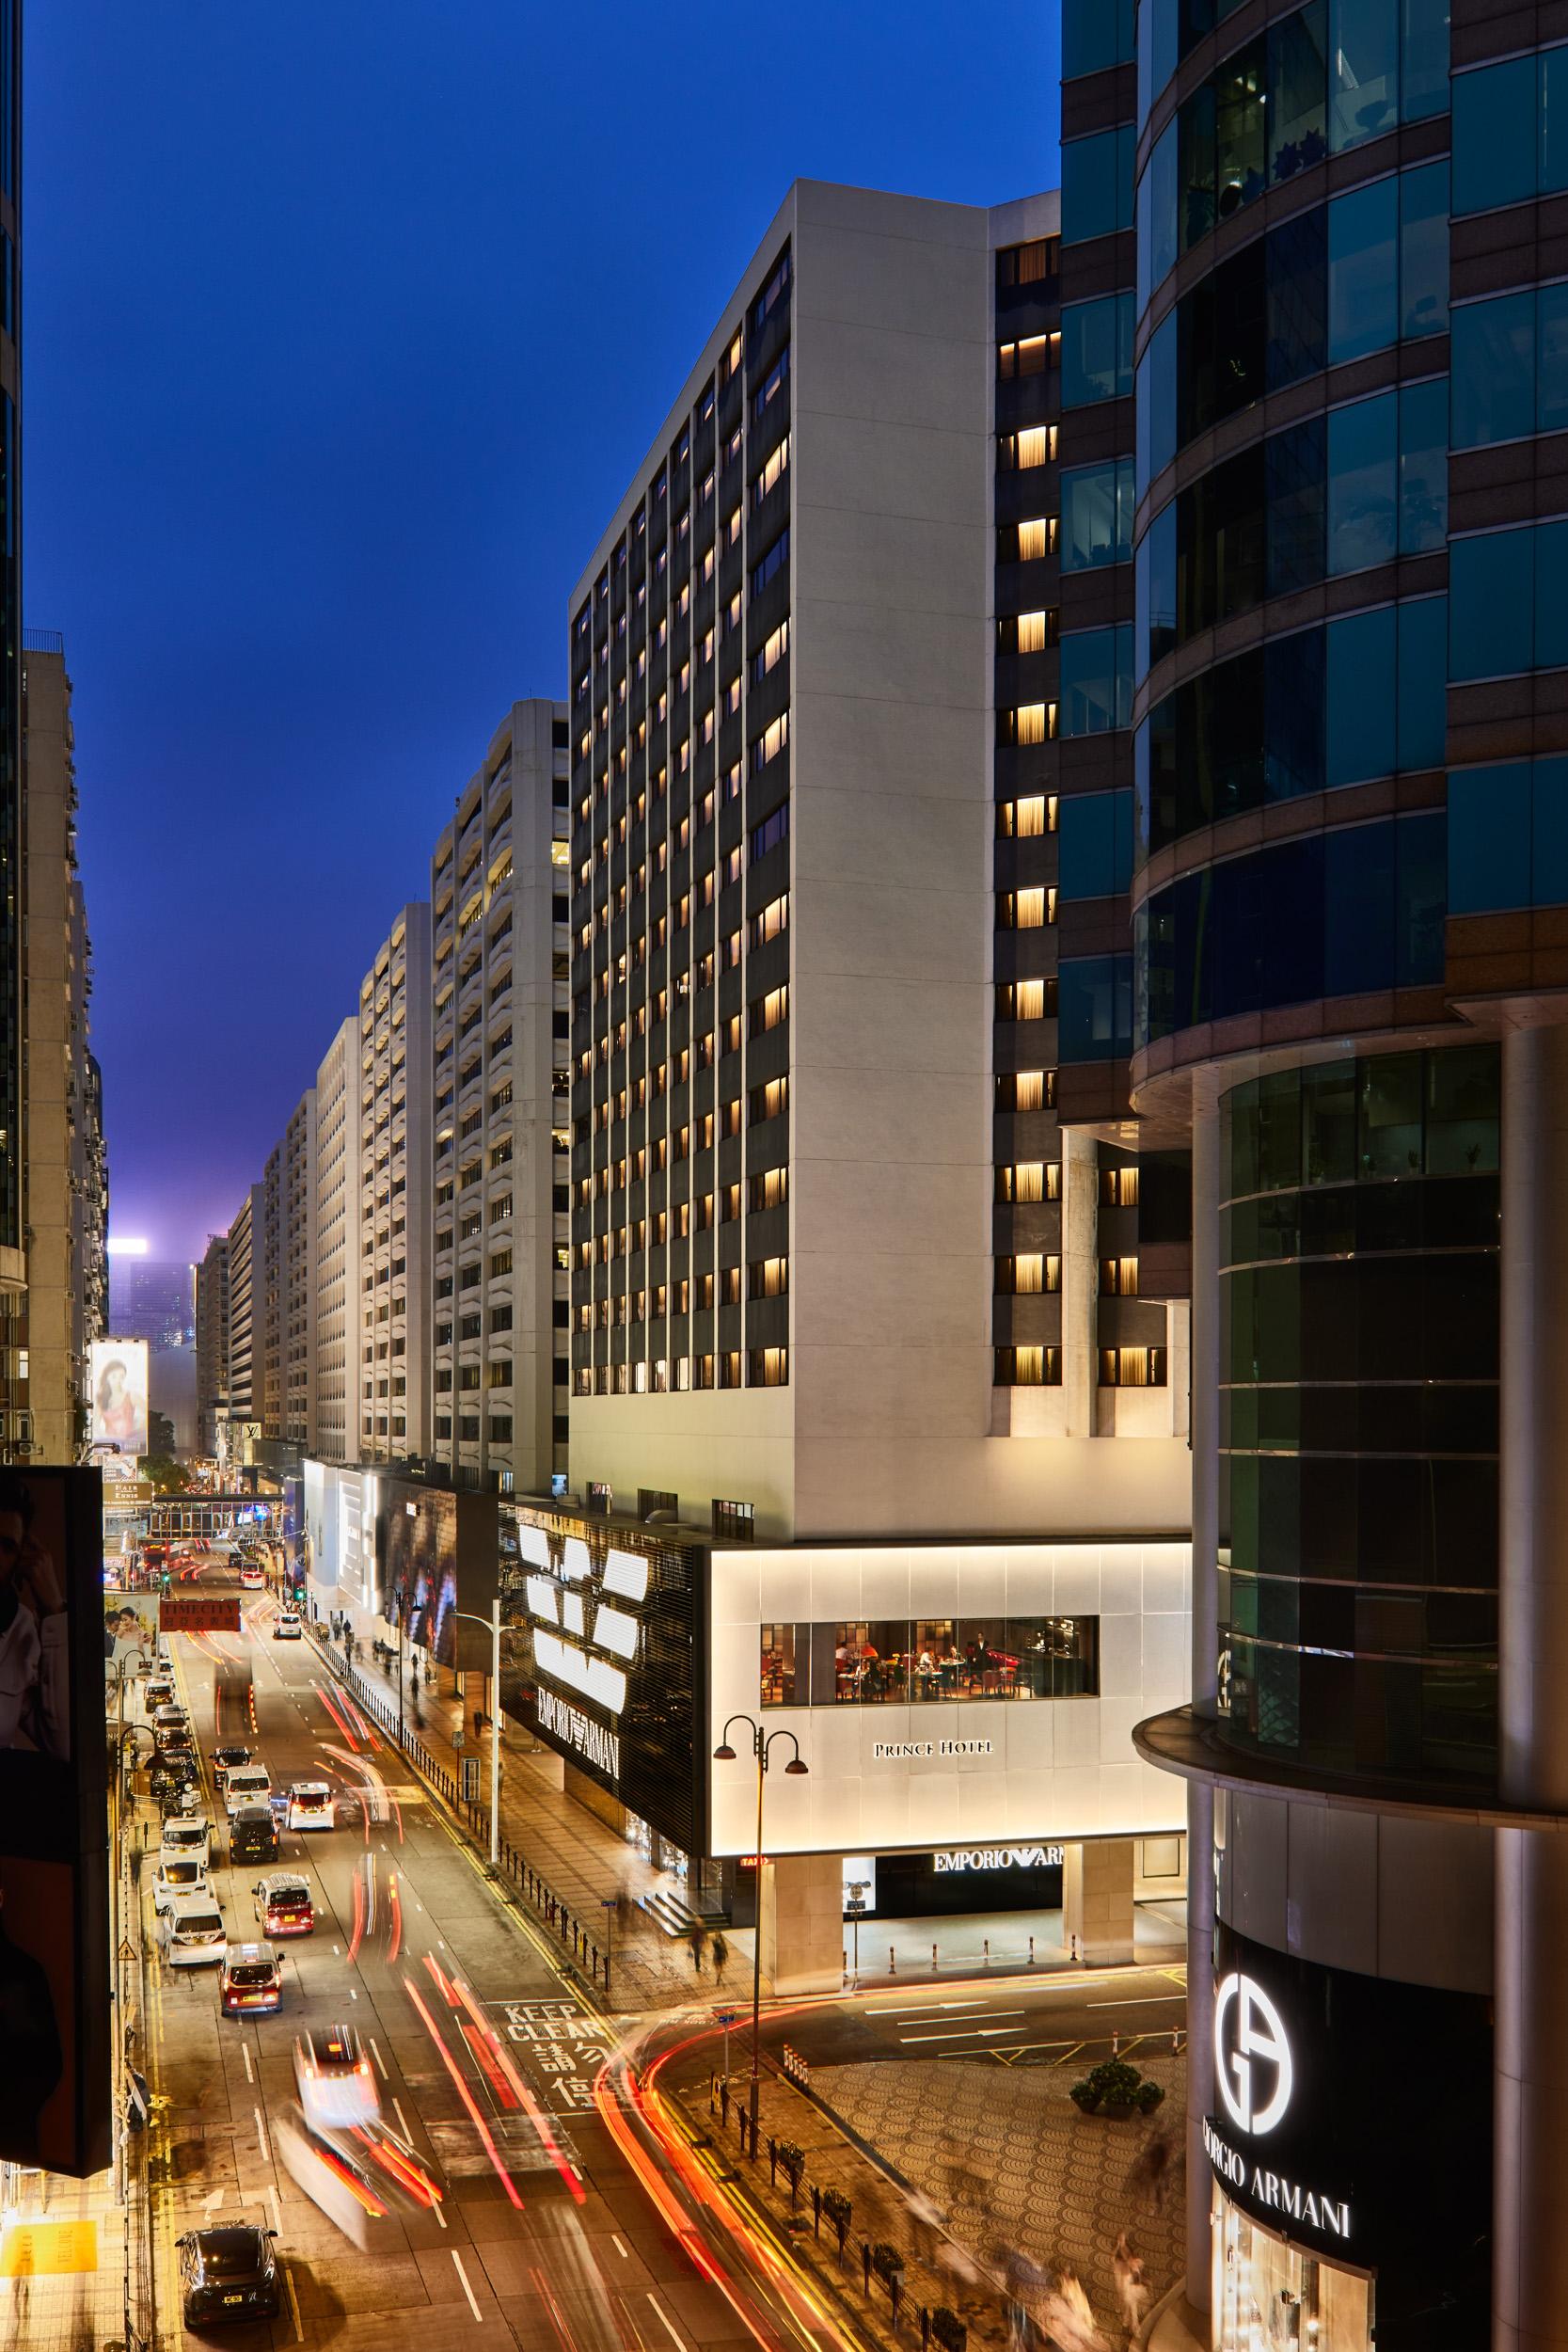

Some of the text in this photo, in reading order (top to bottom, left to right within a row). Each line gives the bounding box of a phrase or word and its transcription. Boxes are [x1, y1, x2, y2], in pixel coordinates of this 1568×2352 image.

[165, 1604, 233, 1614] TIMECITY
[538, 1686, 620, 1780] EMPORIO ARMANI
[875, 1740, 993, 1757] PRINCE HOTEL
[934, 1849, 1013, 1872] EMPORIO
[504, 2005, 577, 2023] KEEP
[507, 2020, 607, 2042] CLEAR
[1251, 2167, 1350, 2238] ARMANI
